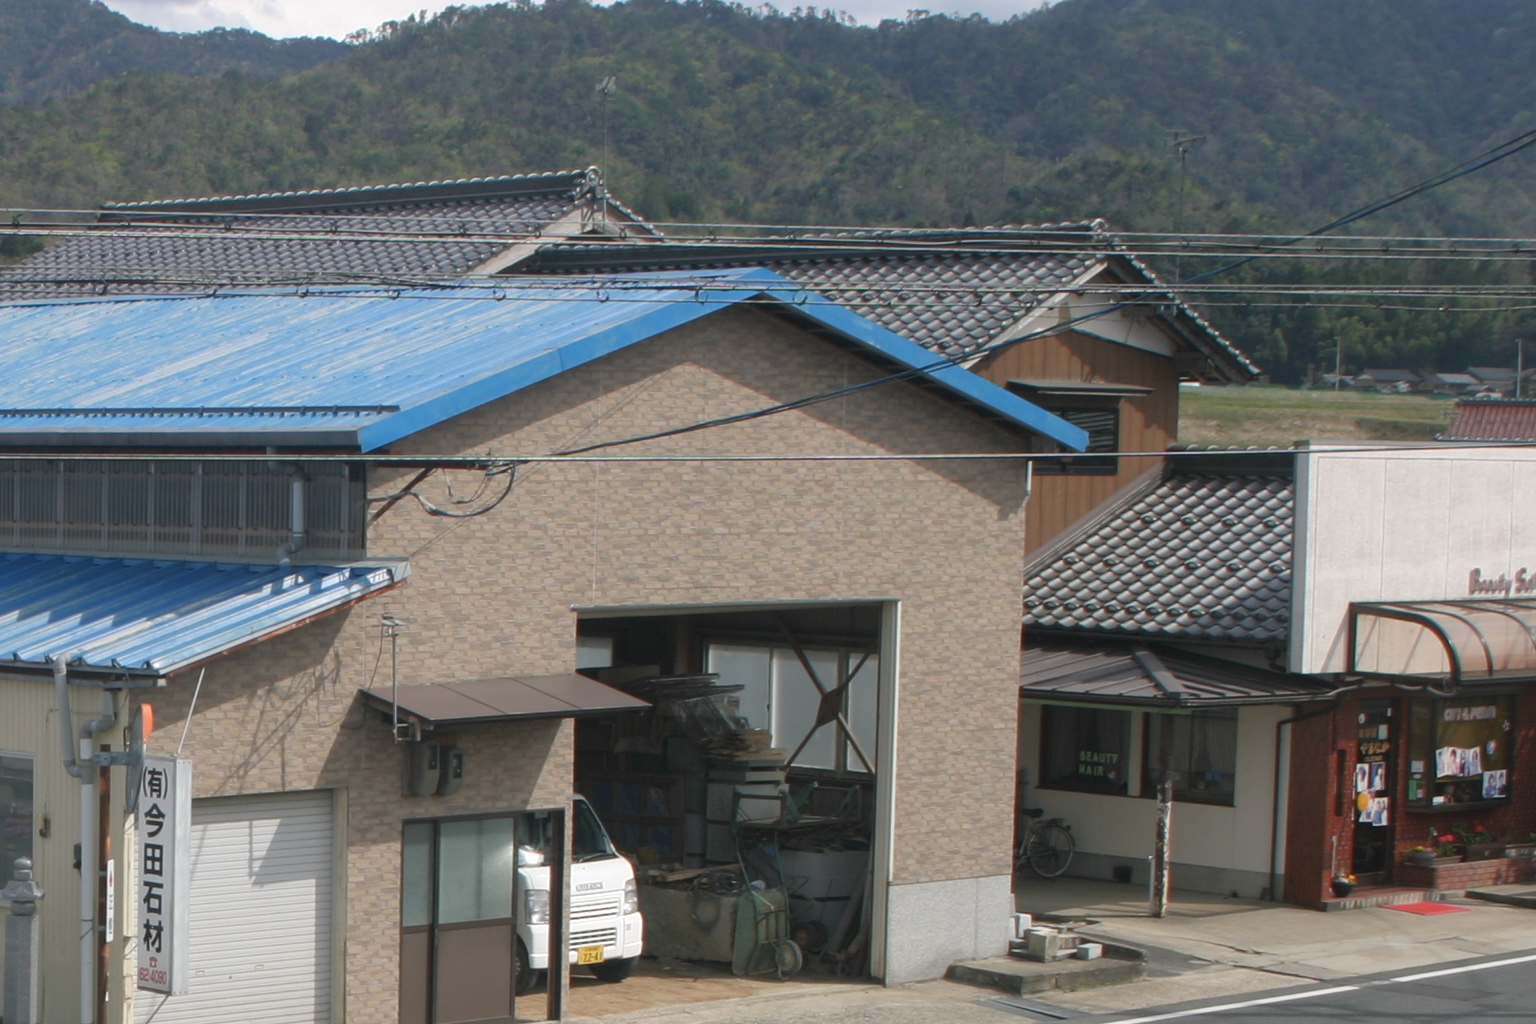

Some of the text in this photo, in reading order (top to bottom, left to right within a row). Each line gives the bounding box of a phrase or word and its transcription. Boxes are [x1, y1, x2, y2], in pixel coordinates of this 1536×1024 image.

[1079, 750, 1119, 764] BEAUTY
[1078, 764, 1104, 776] HAIR
[140, 767, 168, 953] (有)今田石材
